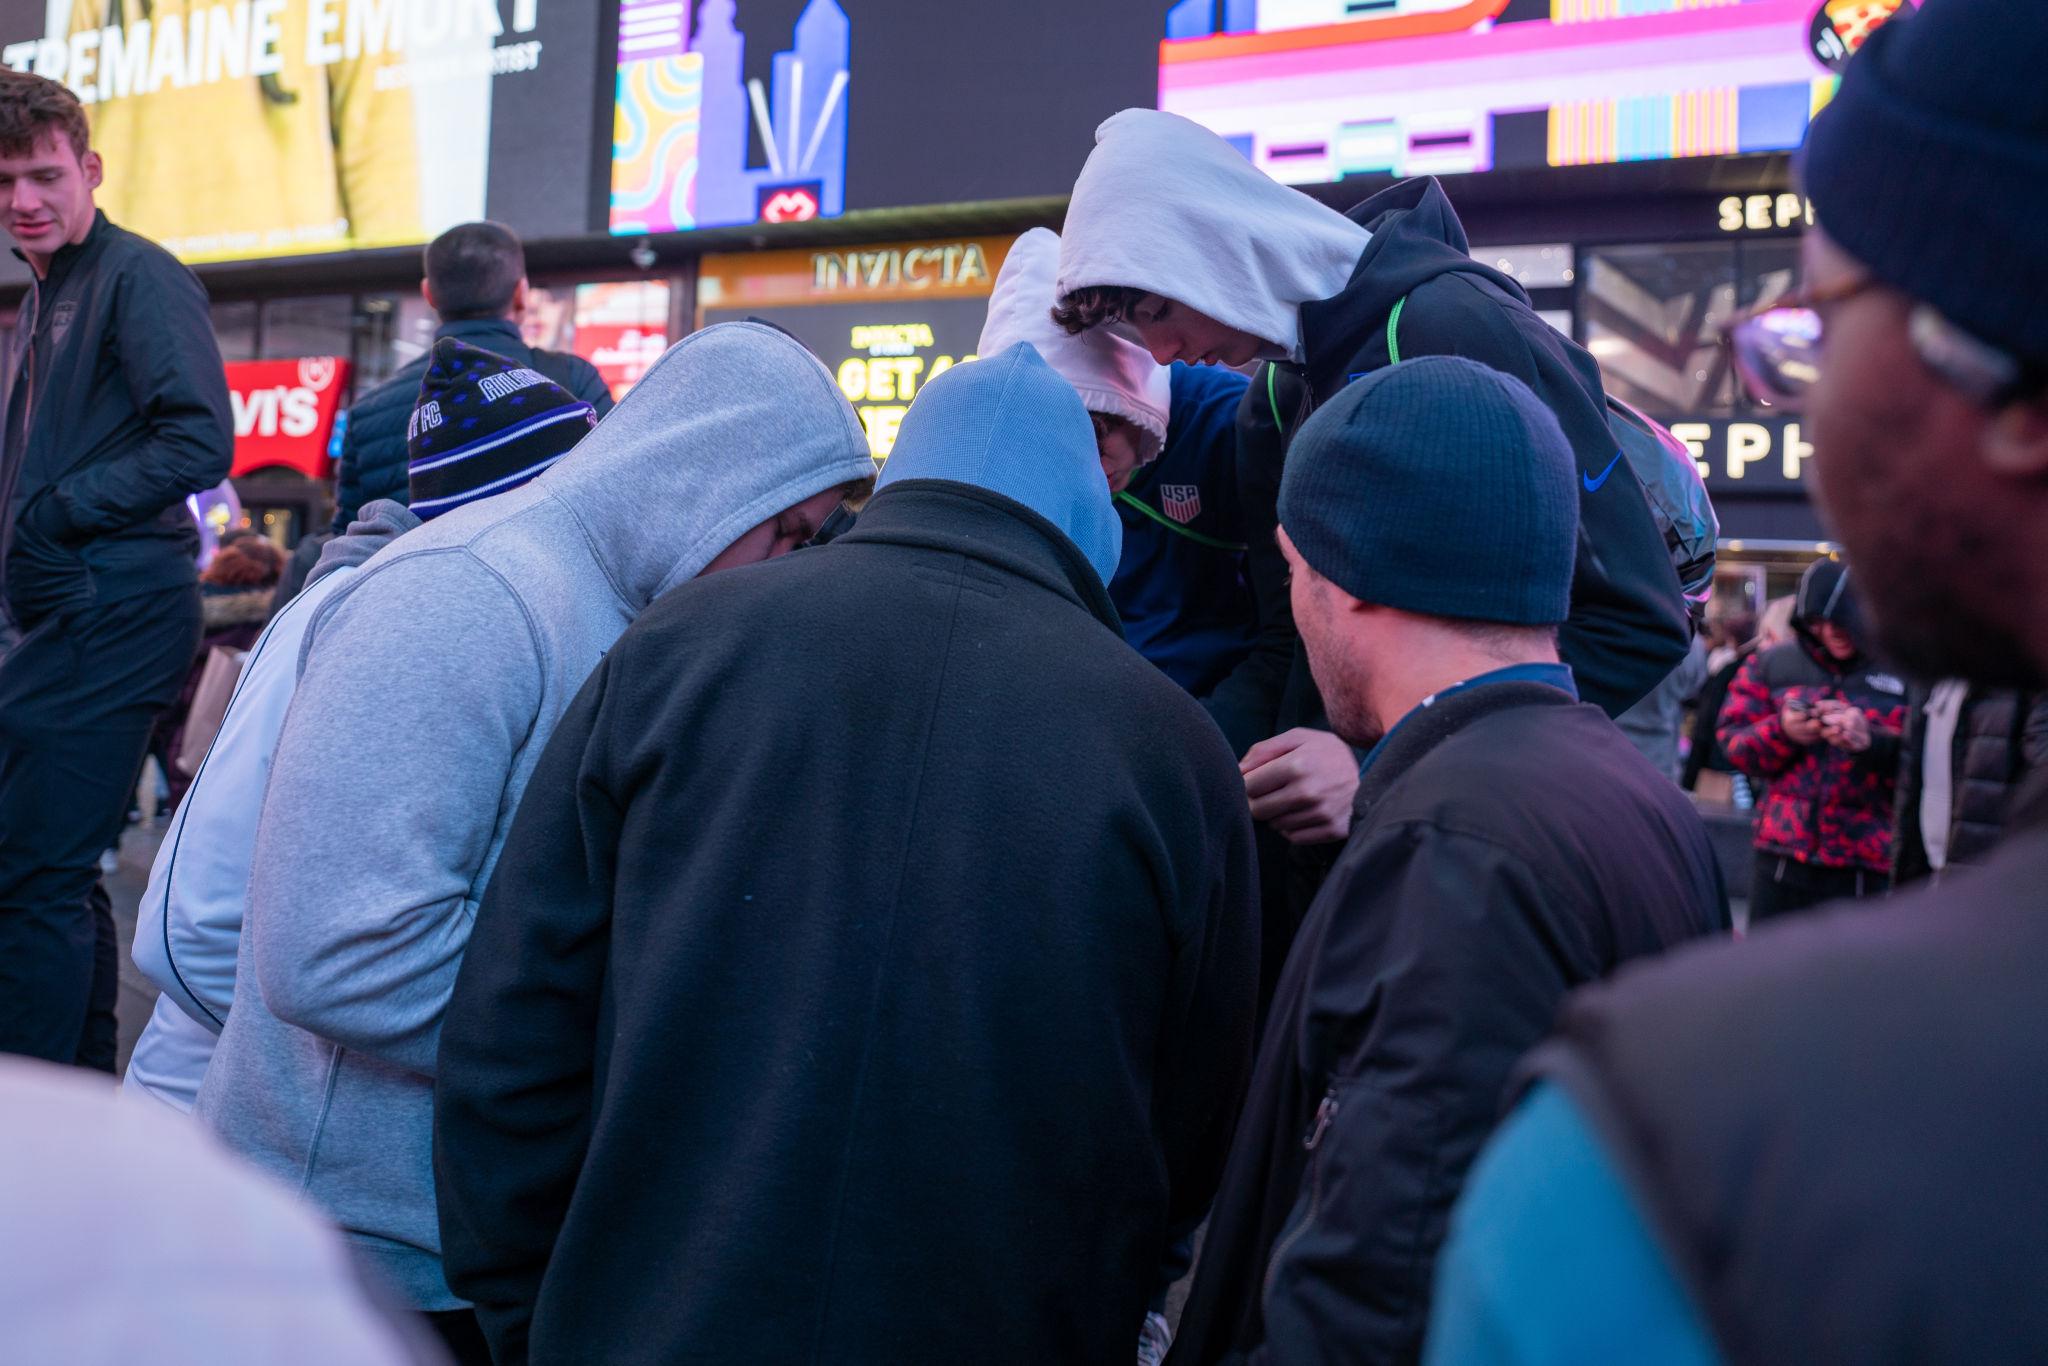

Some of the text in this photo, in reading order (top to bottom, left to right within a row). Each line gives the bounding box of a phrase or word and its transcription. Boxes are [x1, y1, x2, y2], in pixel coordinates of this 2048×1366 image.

[3, 0, 289, 105] TREMAINE
[812, 242, 990, 289] INVICTA
[838, 357, 924, 401] GET
[1162, 486, 1196, 503] USA
